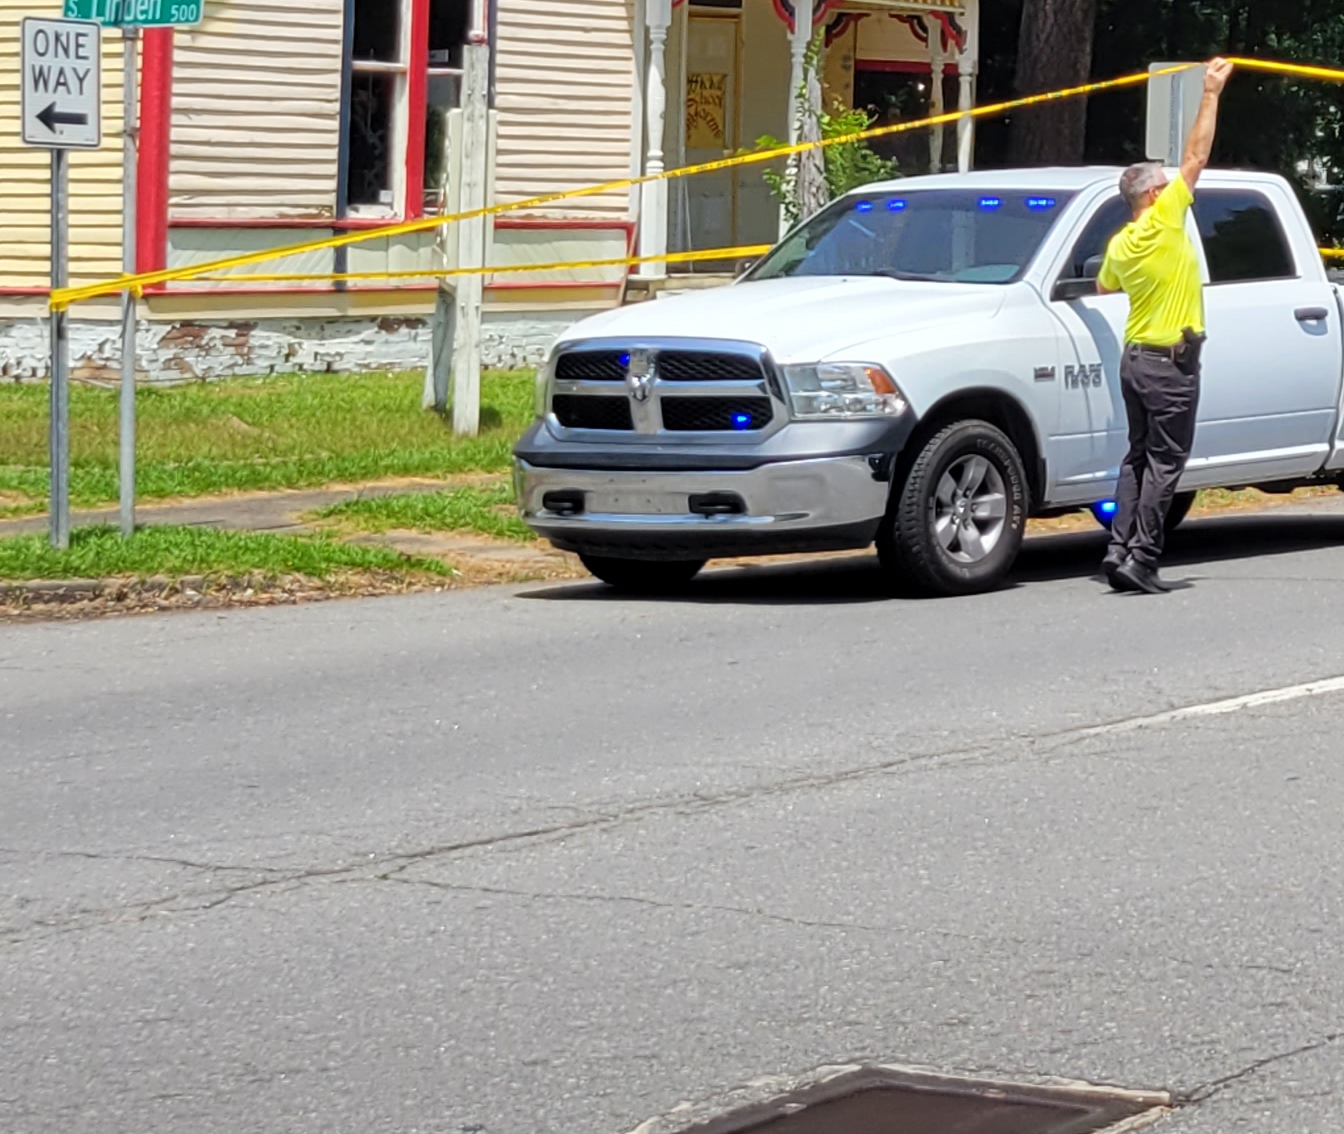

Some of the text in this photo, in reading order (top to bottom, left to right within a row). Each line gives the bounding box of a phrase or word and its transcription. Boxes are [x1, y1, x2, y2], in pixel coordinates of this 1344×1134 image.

[170, 4, 197, 22] 500
[33, 28, 90, 60] ONE
[31, 63, 91, 96] WAY
